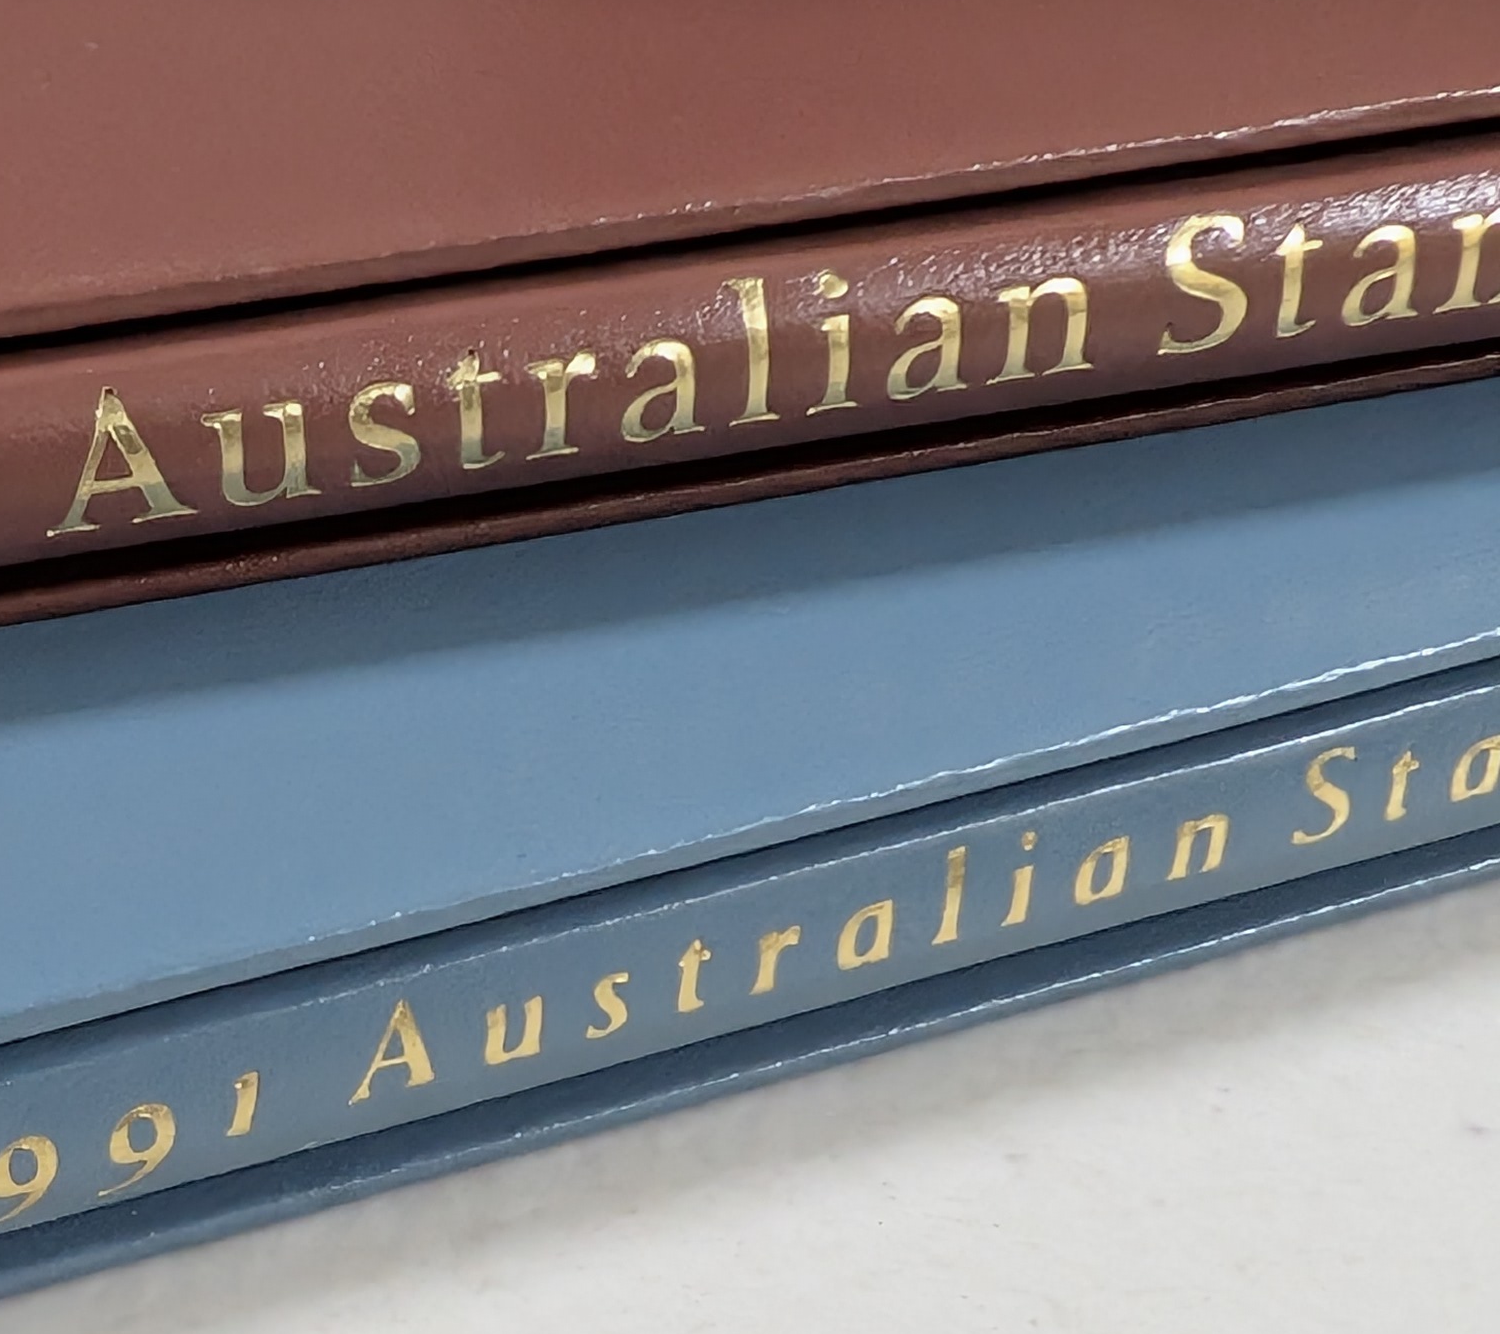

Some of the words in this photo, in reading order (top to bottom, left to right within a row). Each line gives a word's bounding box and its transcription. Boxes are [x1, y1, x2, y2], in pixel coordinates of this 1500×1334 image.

[46, 268, 1095, 537] Australian
[348, 813, 1230, 1107] Australian
[1291, 734, 1500, 846] Sta
